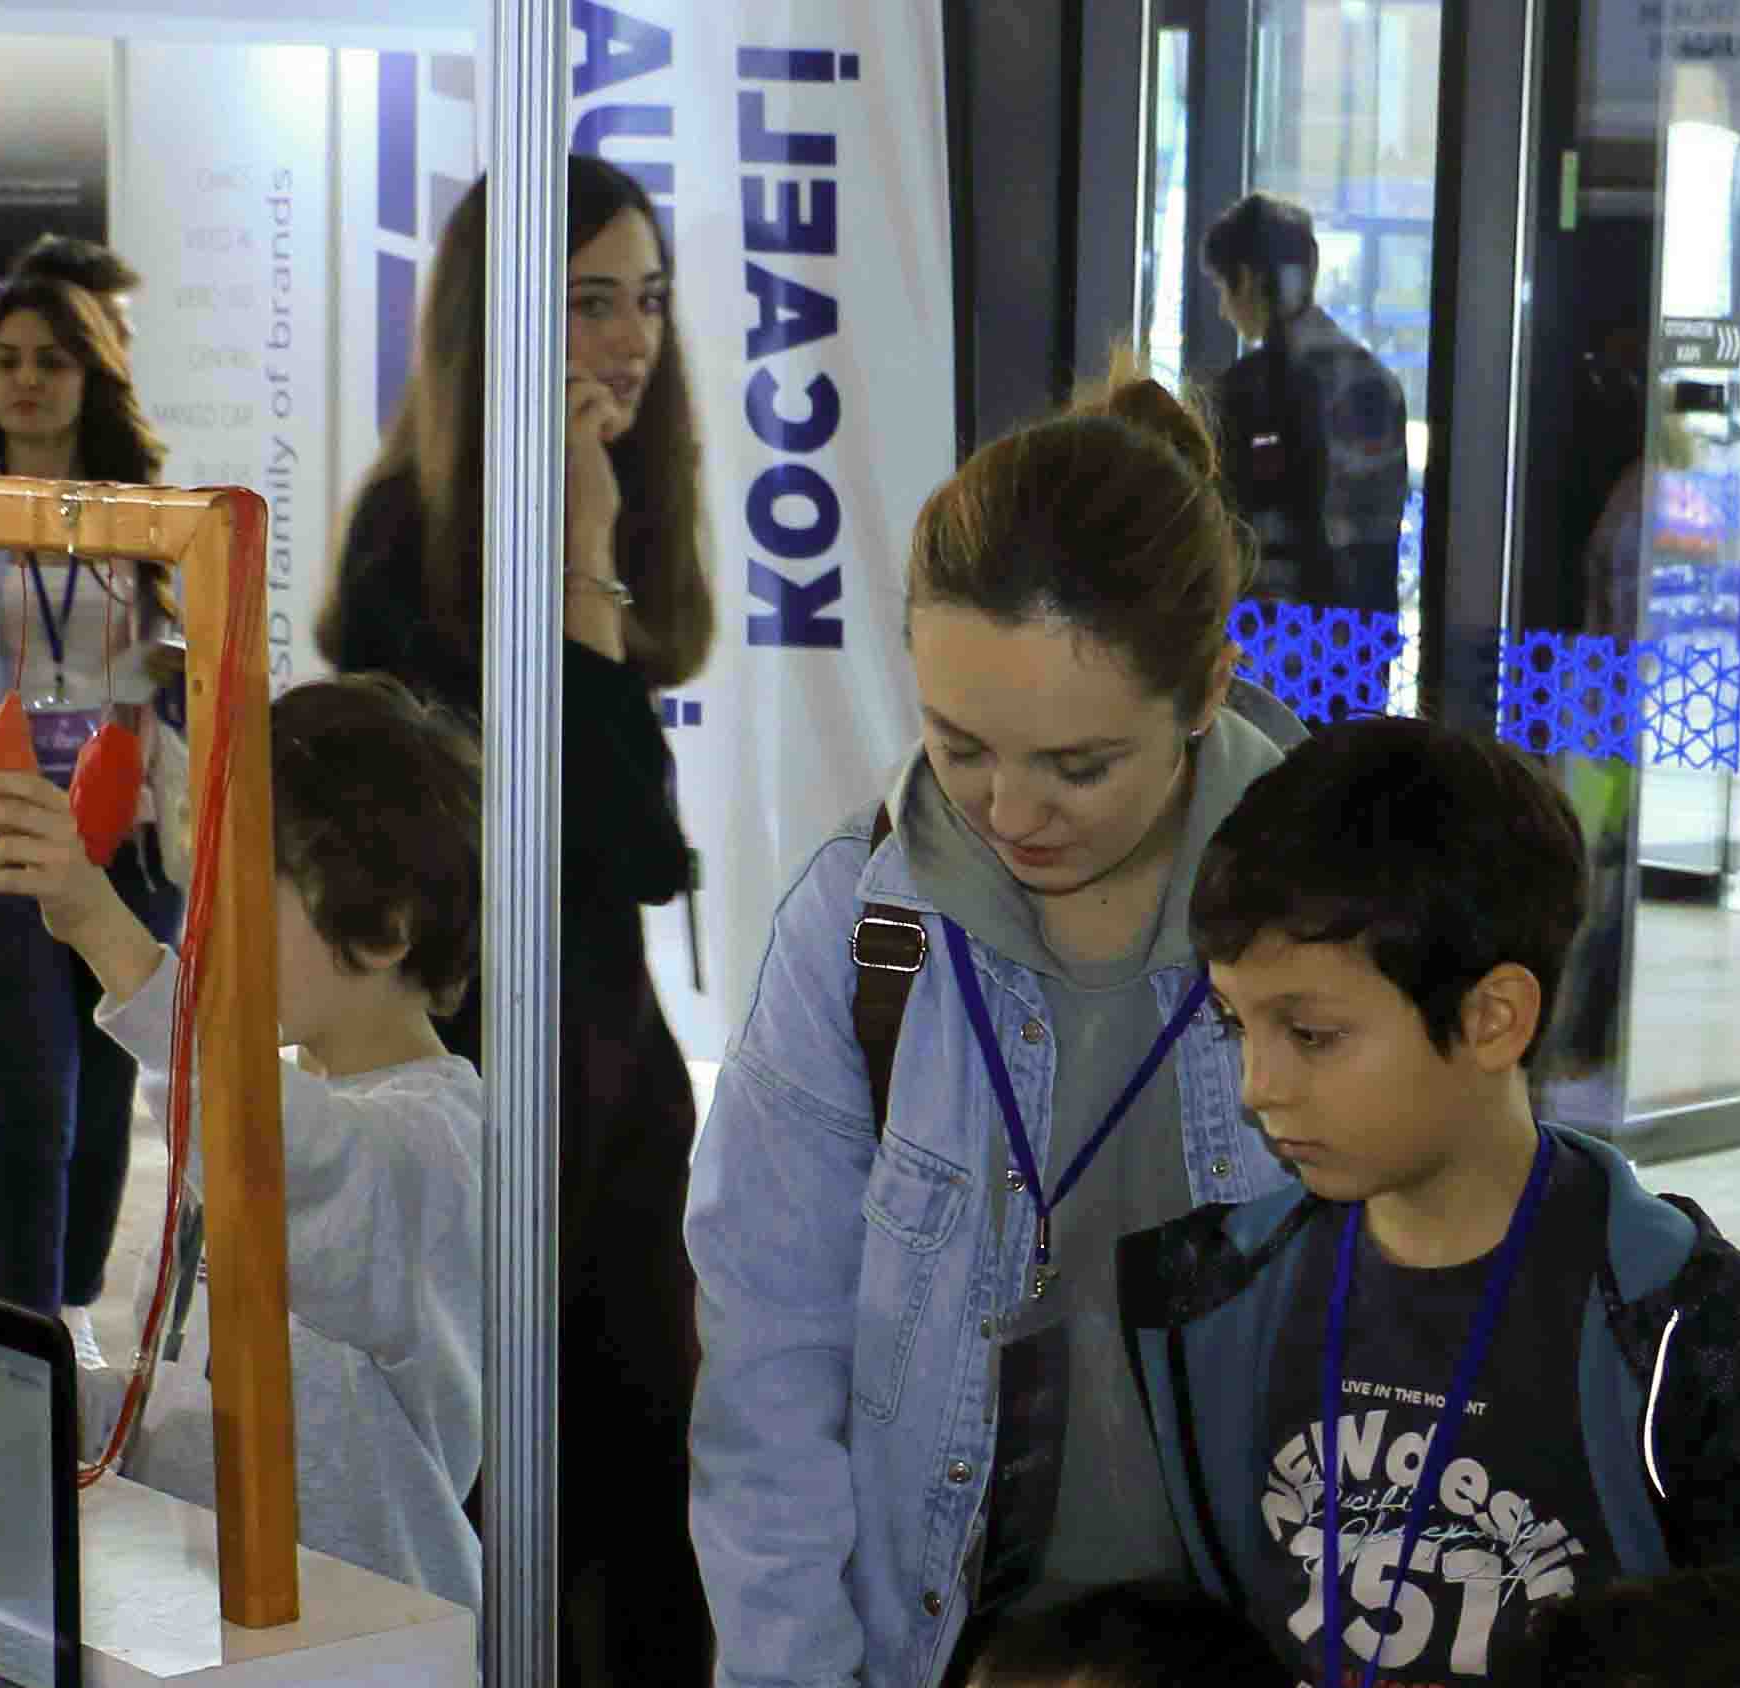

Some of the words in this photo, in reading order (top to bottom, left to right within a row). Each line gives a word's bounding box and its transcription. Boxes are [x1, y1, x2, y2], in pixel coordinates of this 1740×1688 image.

[266, 168, 293, 349] brands
[266, 367, 293, 420] of
[267, 436, 299, 591] family
[1341, 1378, 1372, 1396] LIVE
[1373, 1382, 1392, 1399] IN
[1394, 1386, 1423, 1405] THE
[1423, 1390, 1488, 1416] MONT
